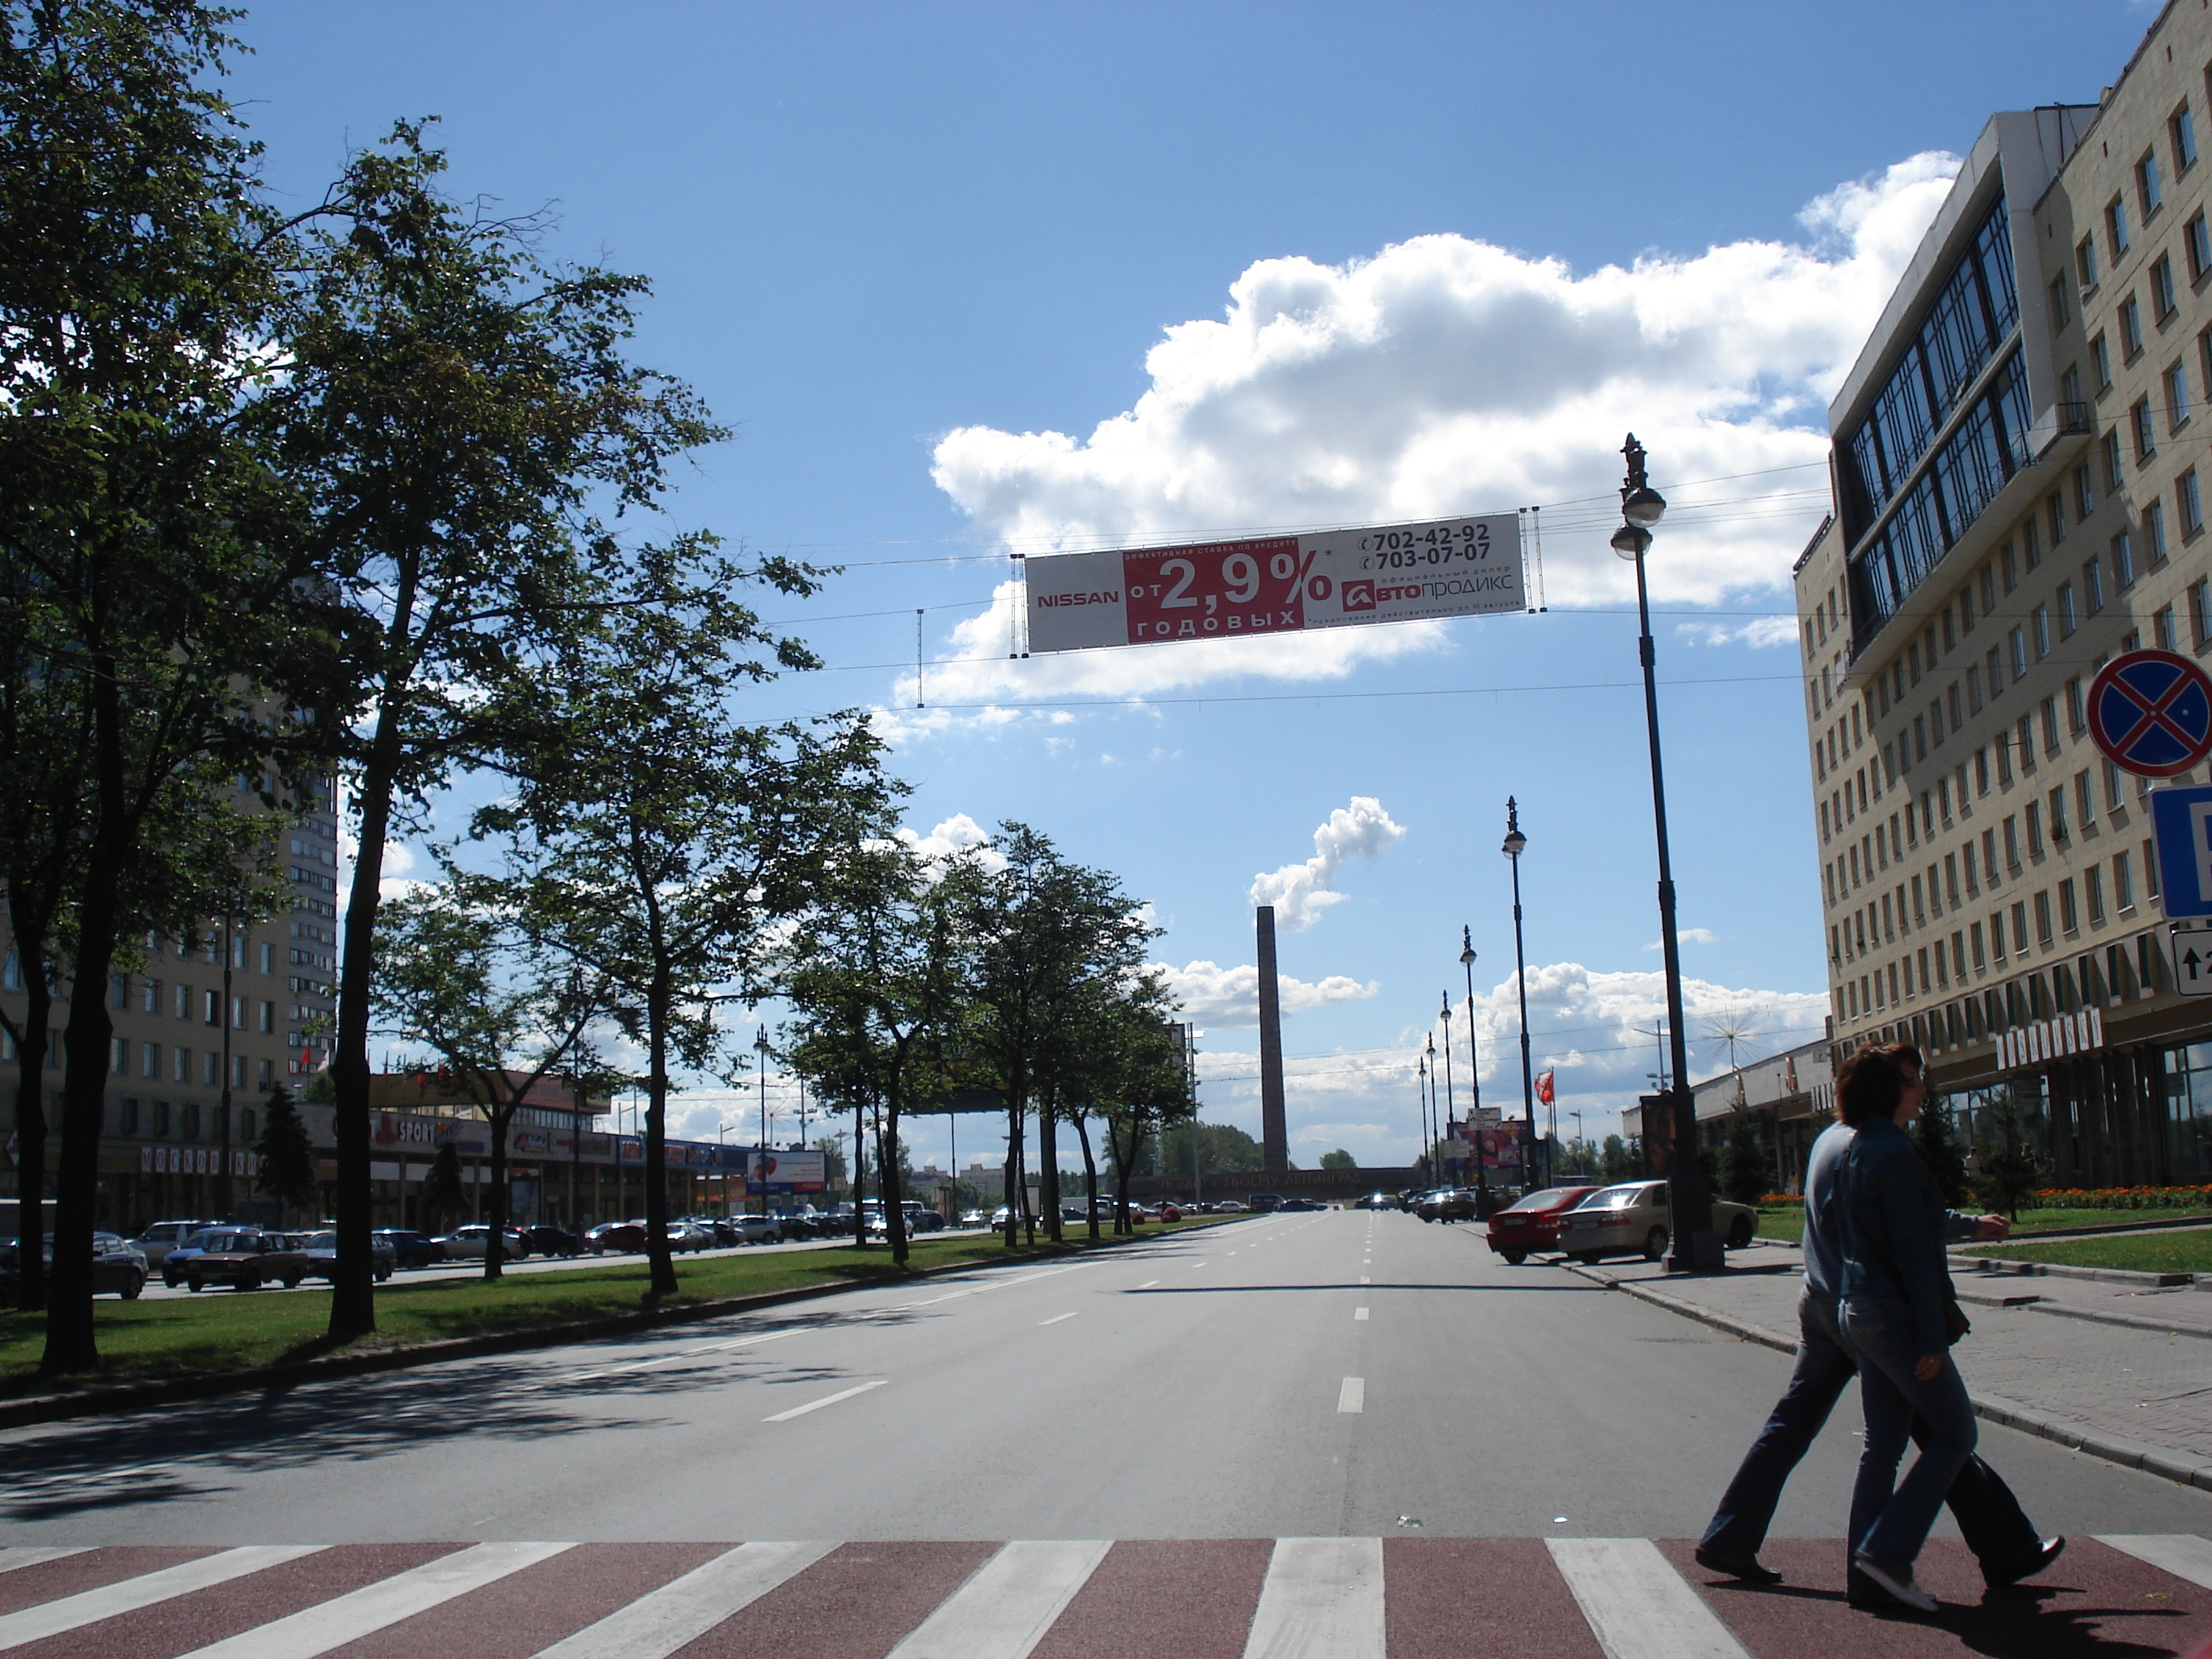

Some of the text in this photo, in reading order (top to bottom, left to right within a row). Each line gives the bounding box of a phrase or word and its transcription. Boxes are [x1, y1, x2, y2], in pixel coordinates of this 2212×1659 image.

[1198, 545, 1234, 554] СТАВКА
[1255, 540, 1297, 549] КРЕДИТУ
[1374, 524, 1489, 551] 702-42-92
[1376, 542, 1490, 569] 703-07-07
[1382, 566, 1510, 583] официальный дилер
[1038, 591, 1119, 608] NISSAN
[1381, 606, 1453, 618] действительно
[1137, 610, 1295, 636] ГОДОВЫХ
[1997, 1013, 2101, 1065] MOSKOVSKY
[398, 1121, 435, 1142] SPORT
[142, 1151, 265, 1173] МОСКОВКИ
[1161, 1177, 1217, 1189] ПОДВГУ
